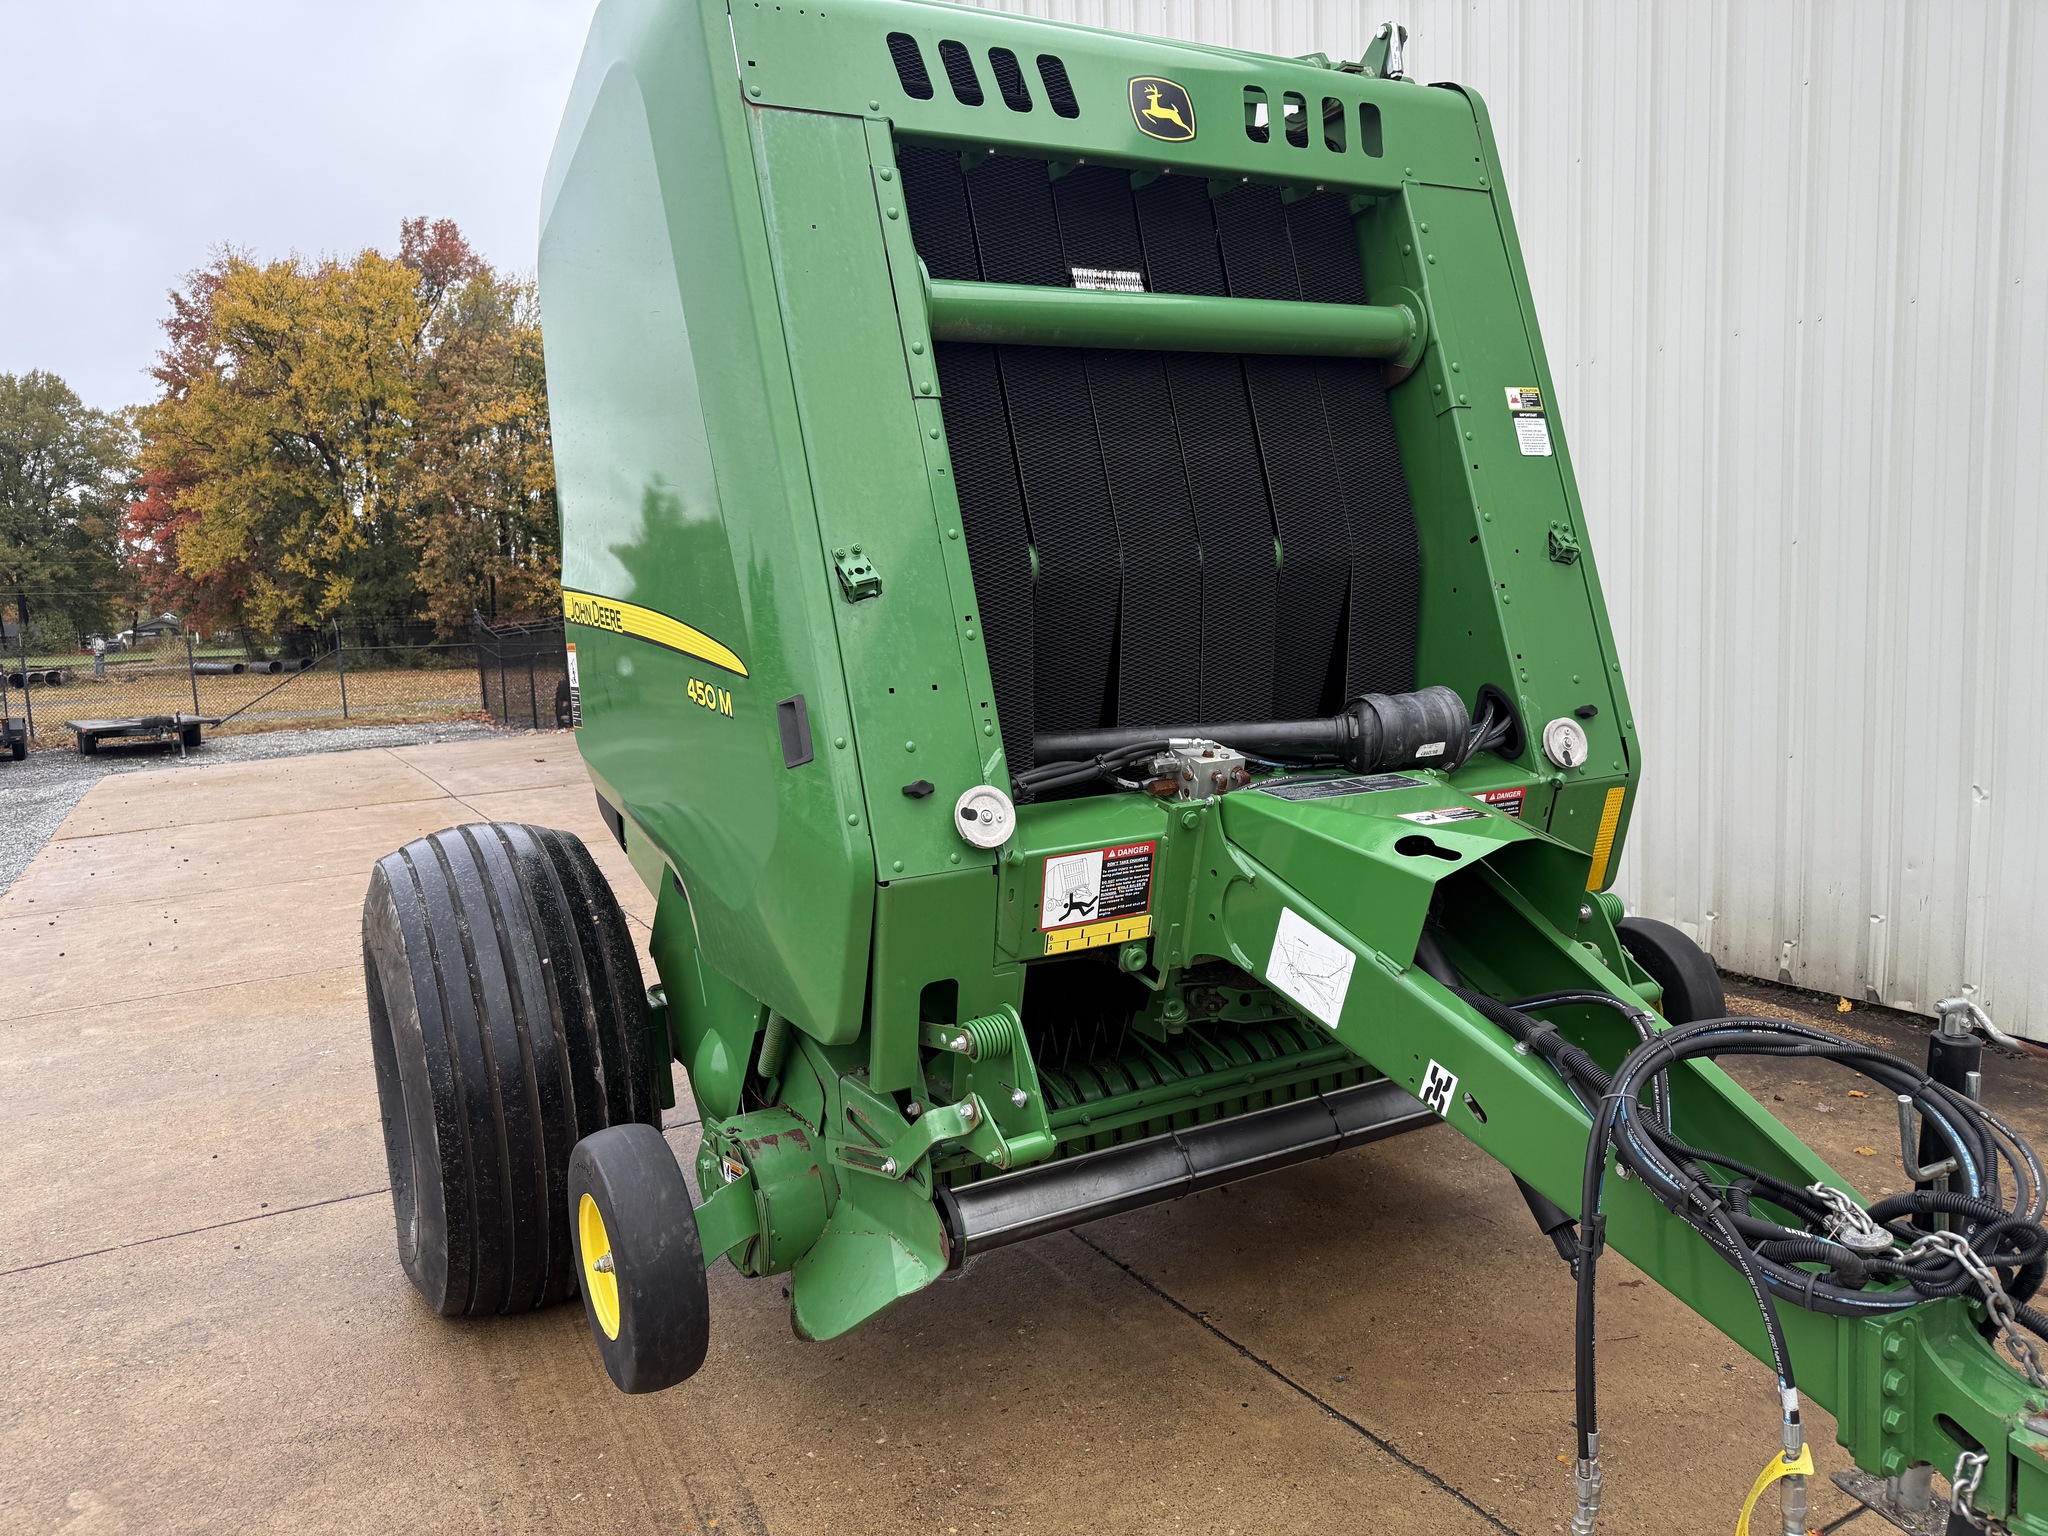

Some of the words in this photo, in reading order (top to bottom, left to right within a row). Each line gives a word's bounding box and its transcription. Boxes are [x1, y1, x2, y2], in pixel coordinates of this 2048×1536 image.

[570, 596, 592, 626] JOHN
[592, 600, 622, 630] DEERE
[687, 676, 716, 712] 450
[717, 686, 734, 720] M
[1496, 790, 1521, 800] DANGER
[1118, 846, 1149, 856] DANGER
[1724, 1233, 1735, 1246] SAE
